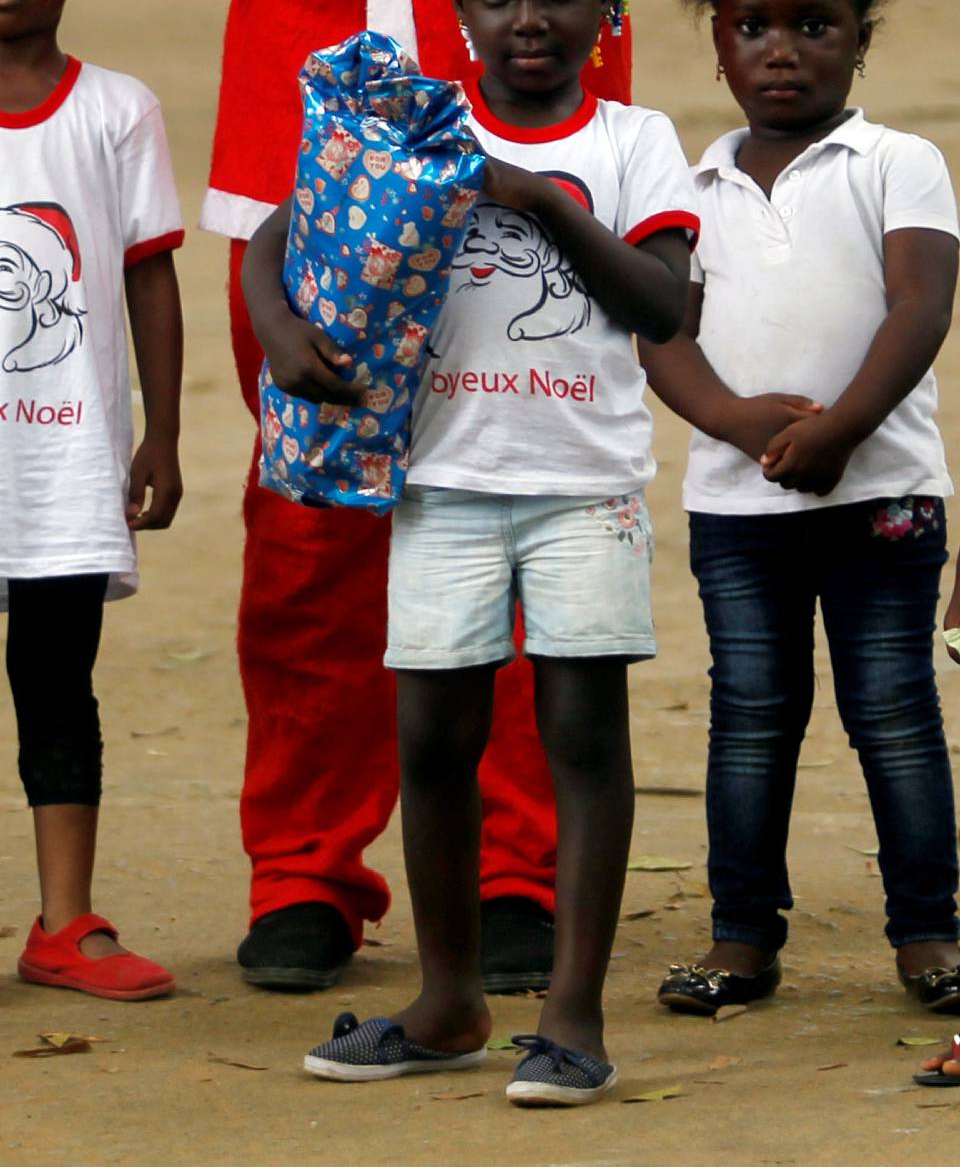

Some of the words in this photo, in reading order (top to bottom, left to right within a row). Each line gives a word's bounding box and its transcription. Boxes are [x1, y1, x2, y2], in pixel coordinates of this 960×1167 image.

[431, 370, 519, 400] oyeux
[529, 368, 596, 402] Noël
[15, 398, 83, 425] Noël
